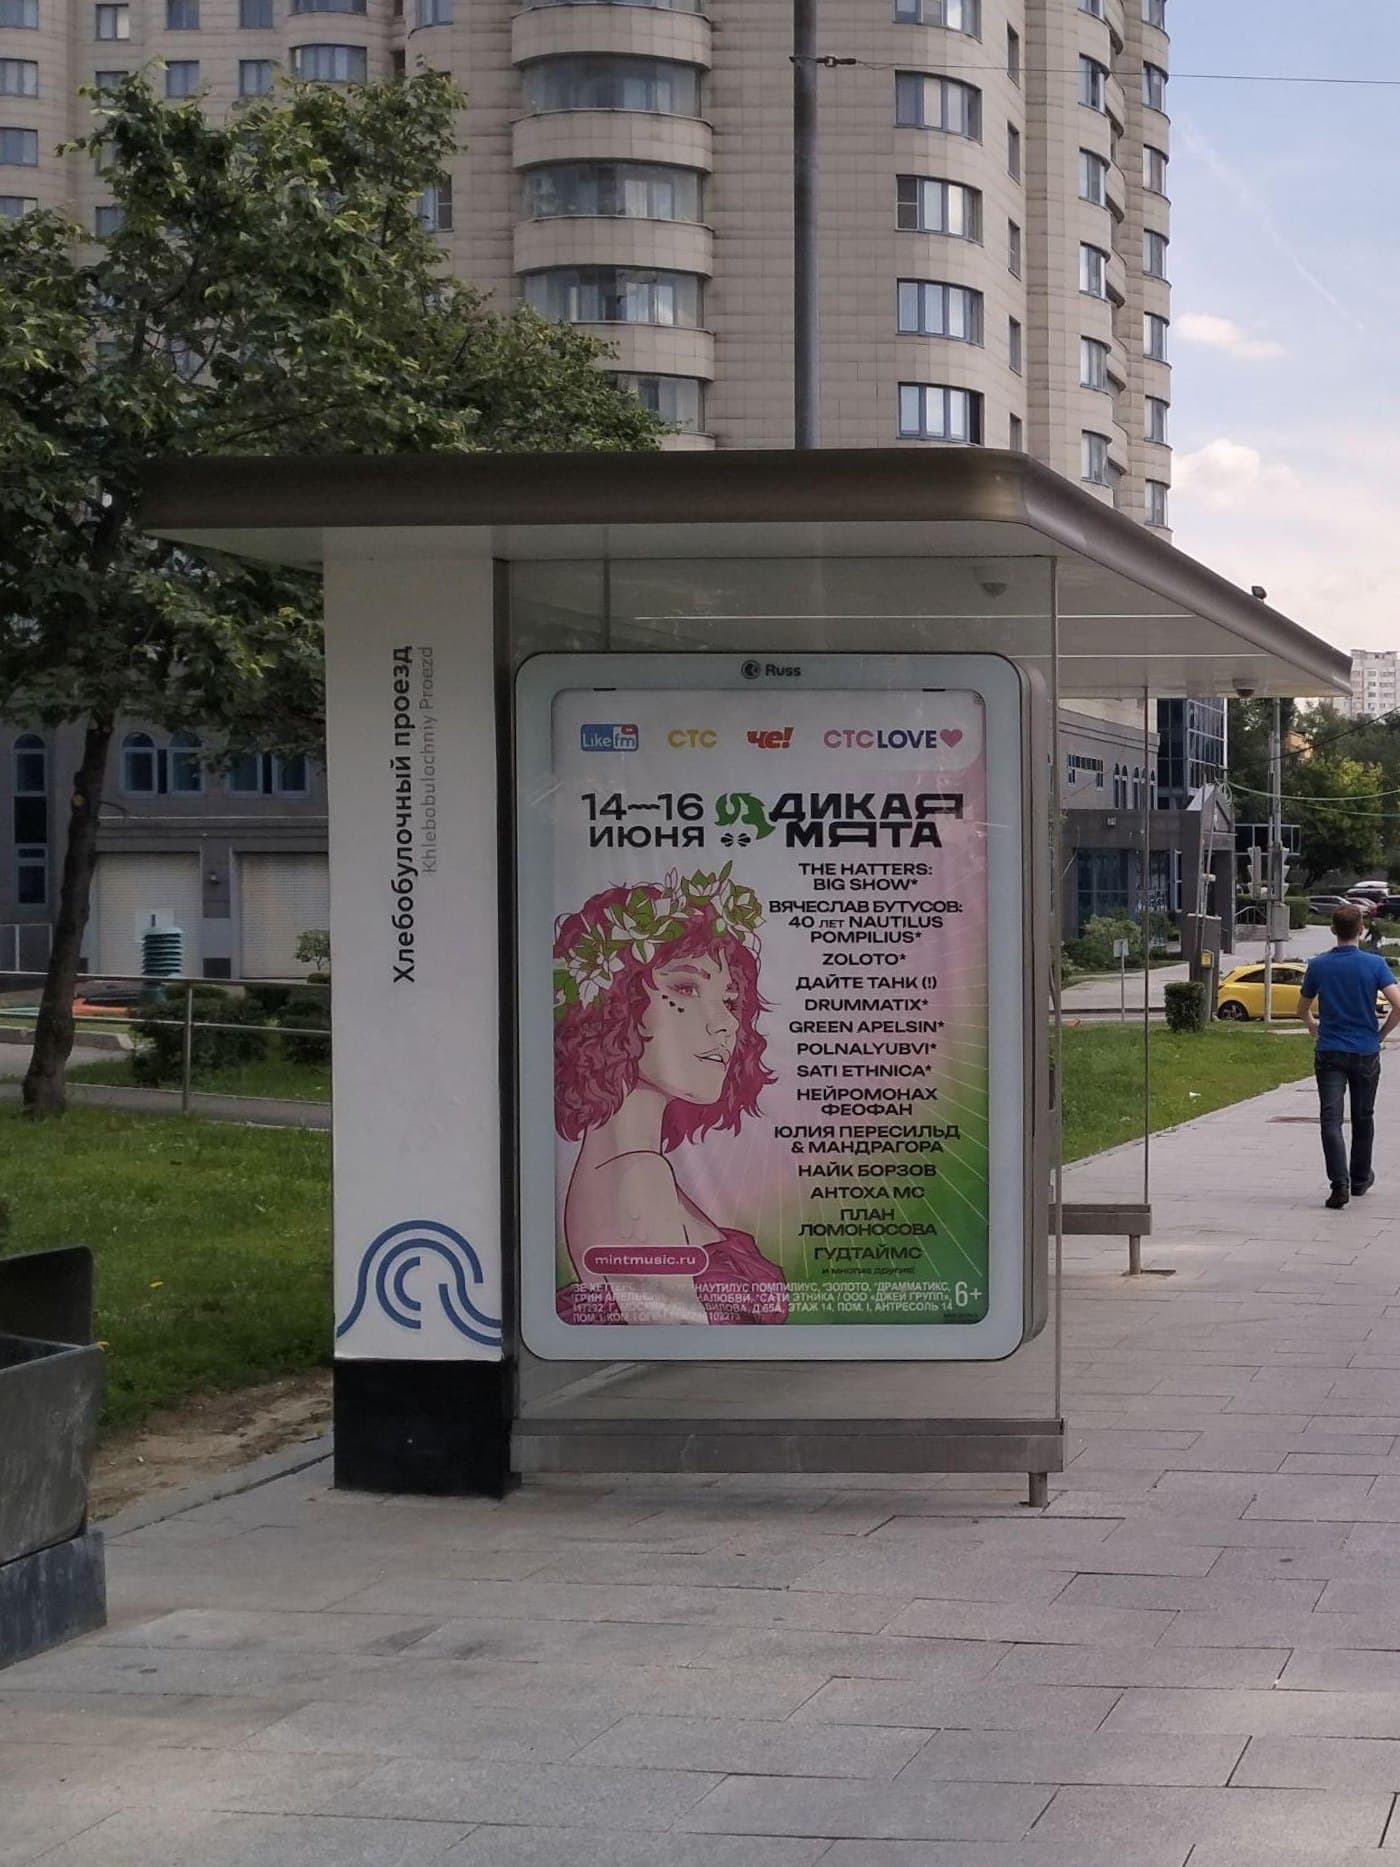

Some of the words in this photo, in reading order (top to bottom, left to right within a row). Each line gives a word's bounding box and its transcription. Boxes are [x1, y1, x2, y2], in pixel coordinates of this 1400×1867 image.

[765, 664, 802, 677] Russ
[418, 647, 433, 710] Proezd
[393, 646, 416, 747] проезд
[668, 729, 717, 748] СТС
[420, 717, 438, 873] Khlebobulochniy
[769, 793, 964, 822] ДИКАЯ
[589, 826, 705, 848] ИЮНЯ
[786, 822, 942, 848] МЯТА
[390, 756, 418, 983] Хлебобулочный
[799, 863, 836, 875] THE
[841, 863, 933, 875] HATTERS:
[814, 878, 845, 891] BIG
[769, 900, 869, 913] ВЯЧЕСЛАВ
[873, 900, 963, 913] БУТУСОВ:
[788, 916, 815, 928] 40
[849, 916, 943, 928] NAUTILUS
[796, 974, 864, 991] ДАЙТЕ
[867, 976, 918, 989] ТАНК
[922, 976, 937, 989] (!)
[789, 1020, 853, 1033] GREEN
[797, 1065, 837, 1077] SATI
[797, 1086, 938, 1100] НЕЙРОМОНАХ
[821, 1103, 912, 1116] ФЕОФАН
[775, 1126, 834, 1138] ЮЛИЯ
[839, 1126, 960, 1140] ПЕРЕСИЛЬД
[791, 1142, 804, 1153] &
[809, 1141, 944, 1155] МАНДРАГОРА
[799, 1162, 853, 1177] НАЙК
[858, 1165, 936, 1177] БОРЗОВ
[810, 1187, 890, 1199] АНТОХА
[840, 1209, 895, 1220] ПЛАН
[798, 1224, 937, 1236] ЛОМОНОСОВА
[595, 1254, 696, 1265] mintmusic.ru
[814, 1245, 922, 1260] ГУДТАЙМС
[955, 1281, 982, 1307] 6+
[875, 1303, 938, 1311] АНТРЕСОЛЬ
